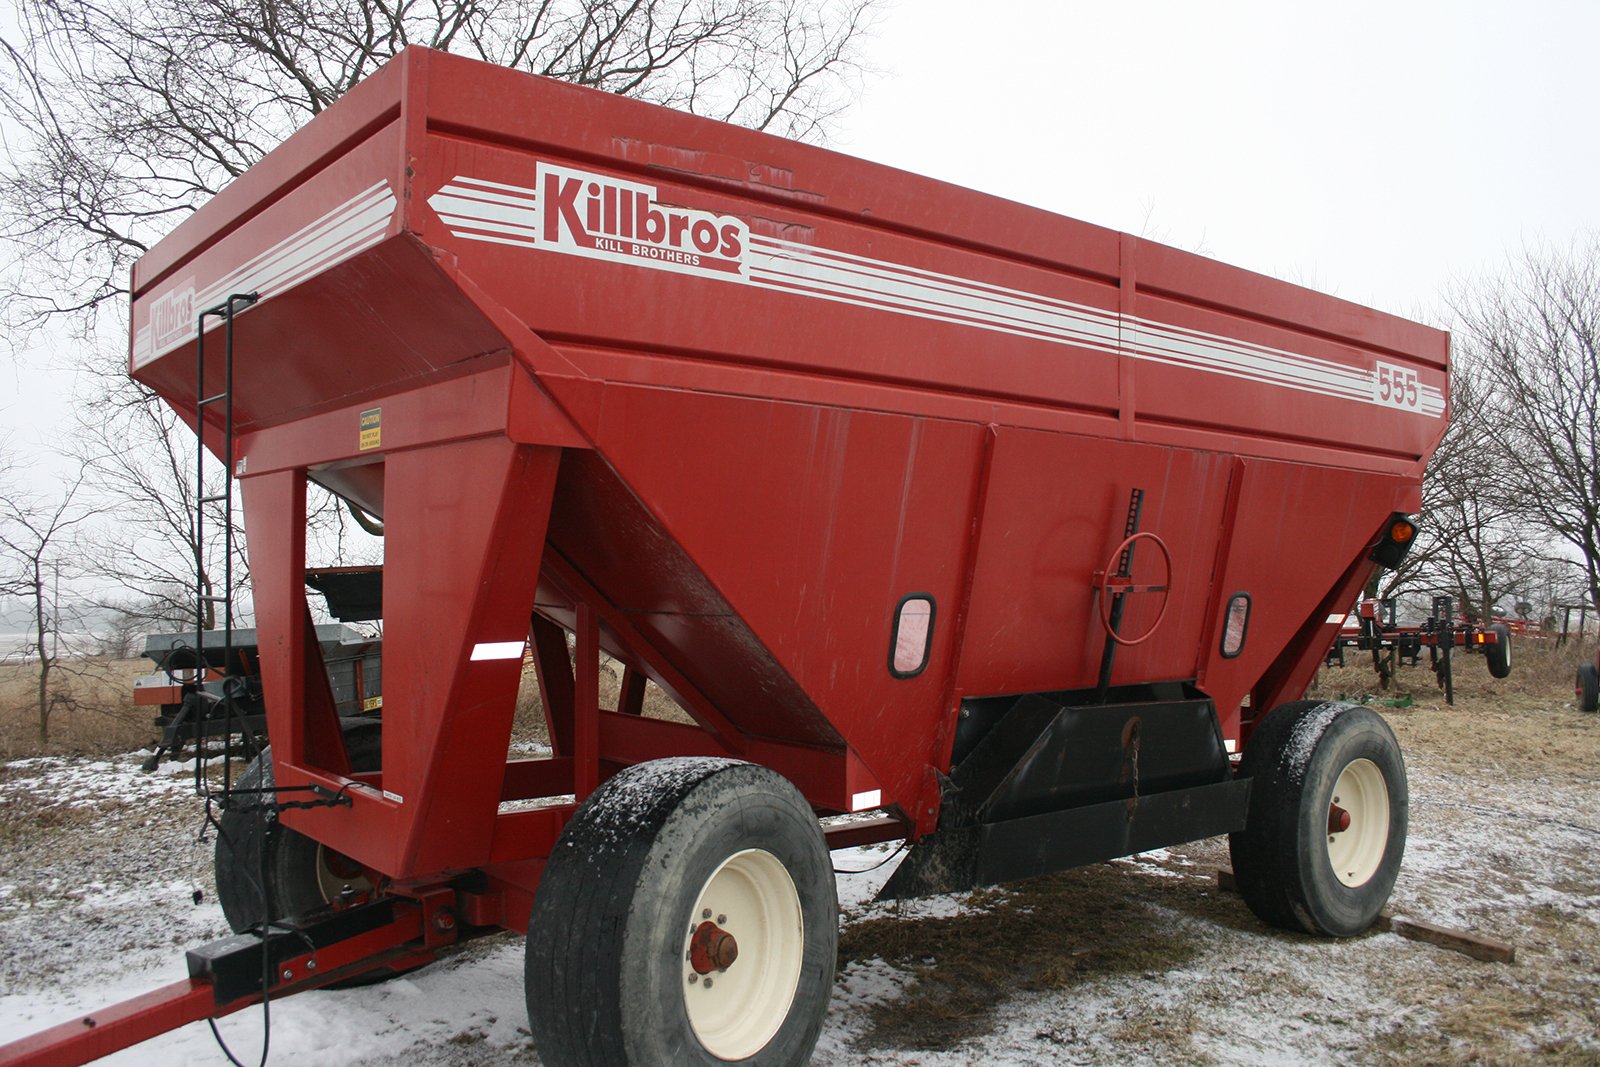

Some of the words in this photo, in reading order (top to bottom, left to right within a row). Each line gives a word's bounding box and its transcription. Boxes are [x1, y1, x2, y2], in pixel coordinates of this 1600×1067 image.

[544, 173, 742, 258] Killbros
[595, 237, 623, 254] KILL
[632, 244, 701, 266] BROTHERS
[151, 294, 194, 354] Killbros
[1379, 367, 1417, 407] 555
